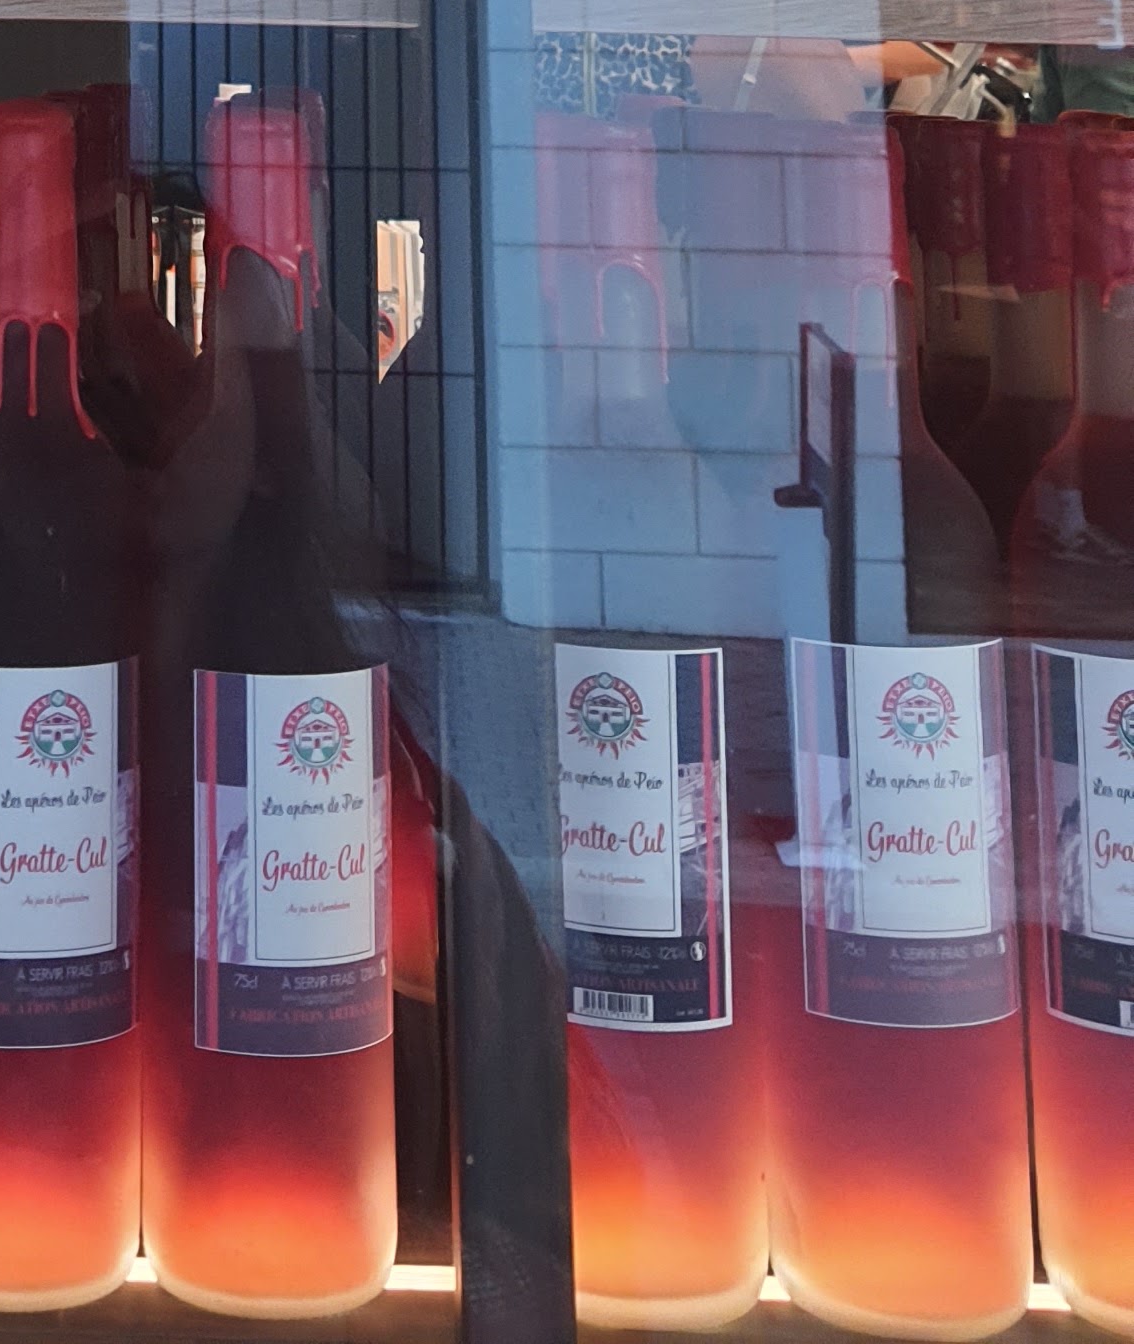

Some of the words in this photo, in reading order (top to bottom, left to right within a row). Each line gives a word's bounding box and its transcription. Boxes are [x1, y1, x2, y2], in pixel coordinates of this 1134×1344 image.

[617, 771, 631, 789] de
[633, 771, 665, 790] Peio
[866, 768, 886, 789] Les
[890, 774, 931, 795] apéros
[933, 770, 946, 789] de
[0, 788, 21, 810] Les
[25, 791, 64, 814] apéros
[66, 787, 80, 807] de
[261, 795, 284, 817] Les
[286, 798, 325, 821] apéros
[327, 795, 340, 813] de
[867, 819, 977, 863] Gratte-Cul
[0, 835, 107, 885] Gratte-Cul
[261, 842, 366, 892] Gratte-Cul
